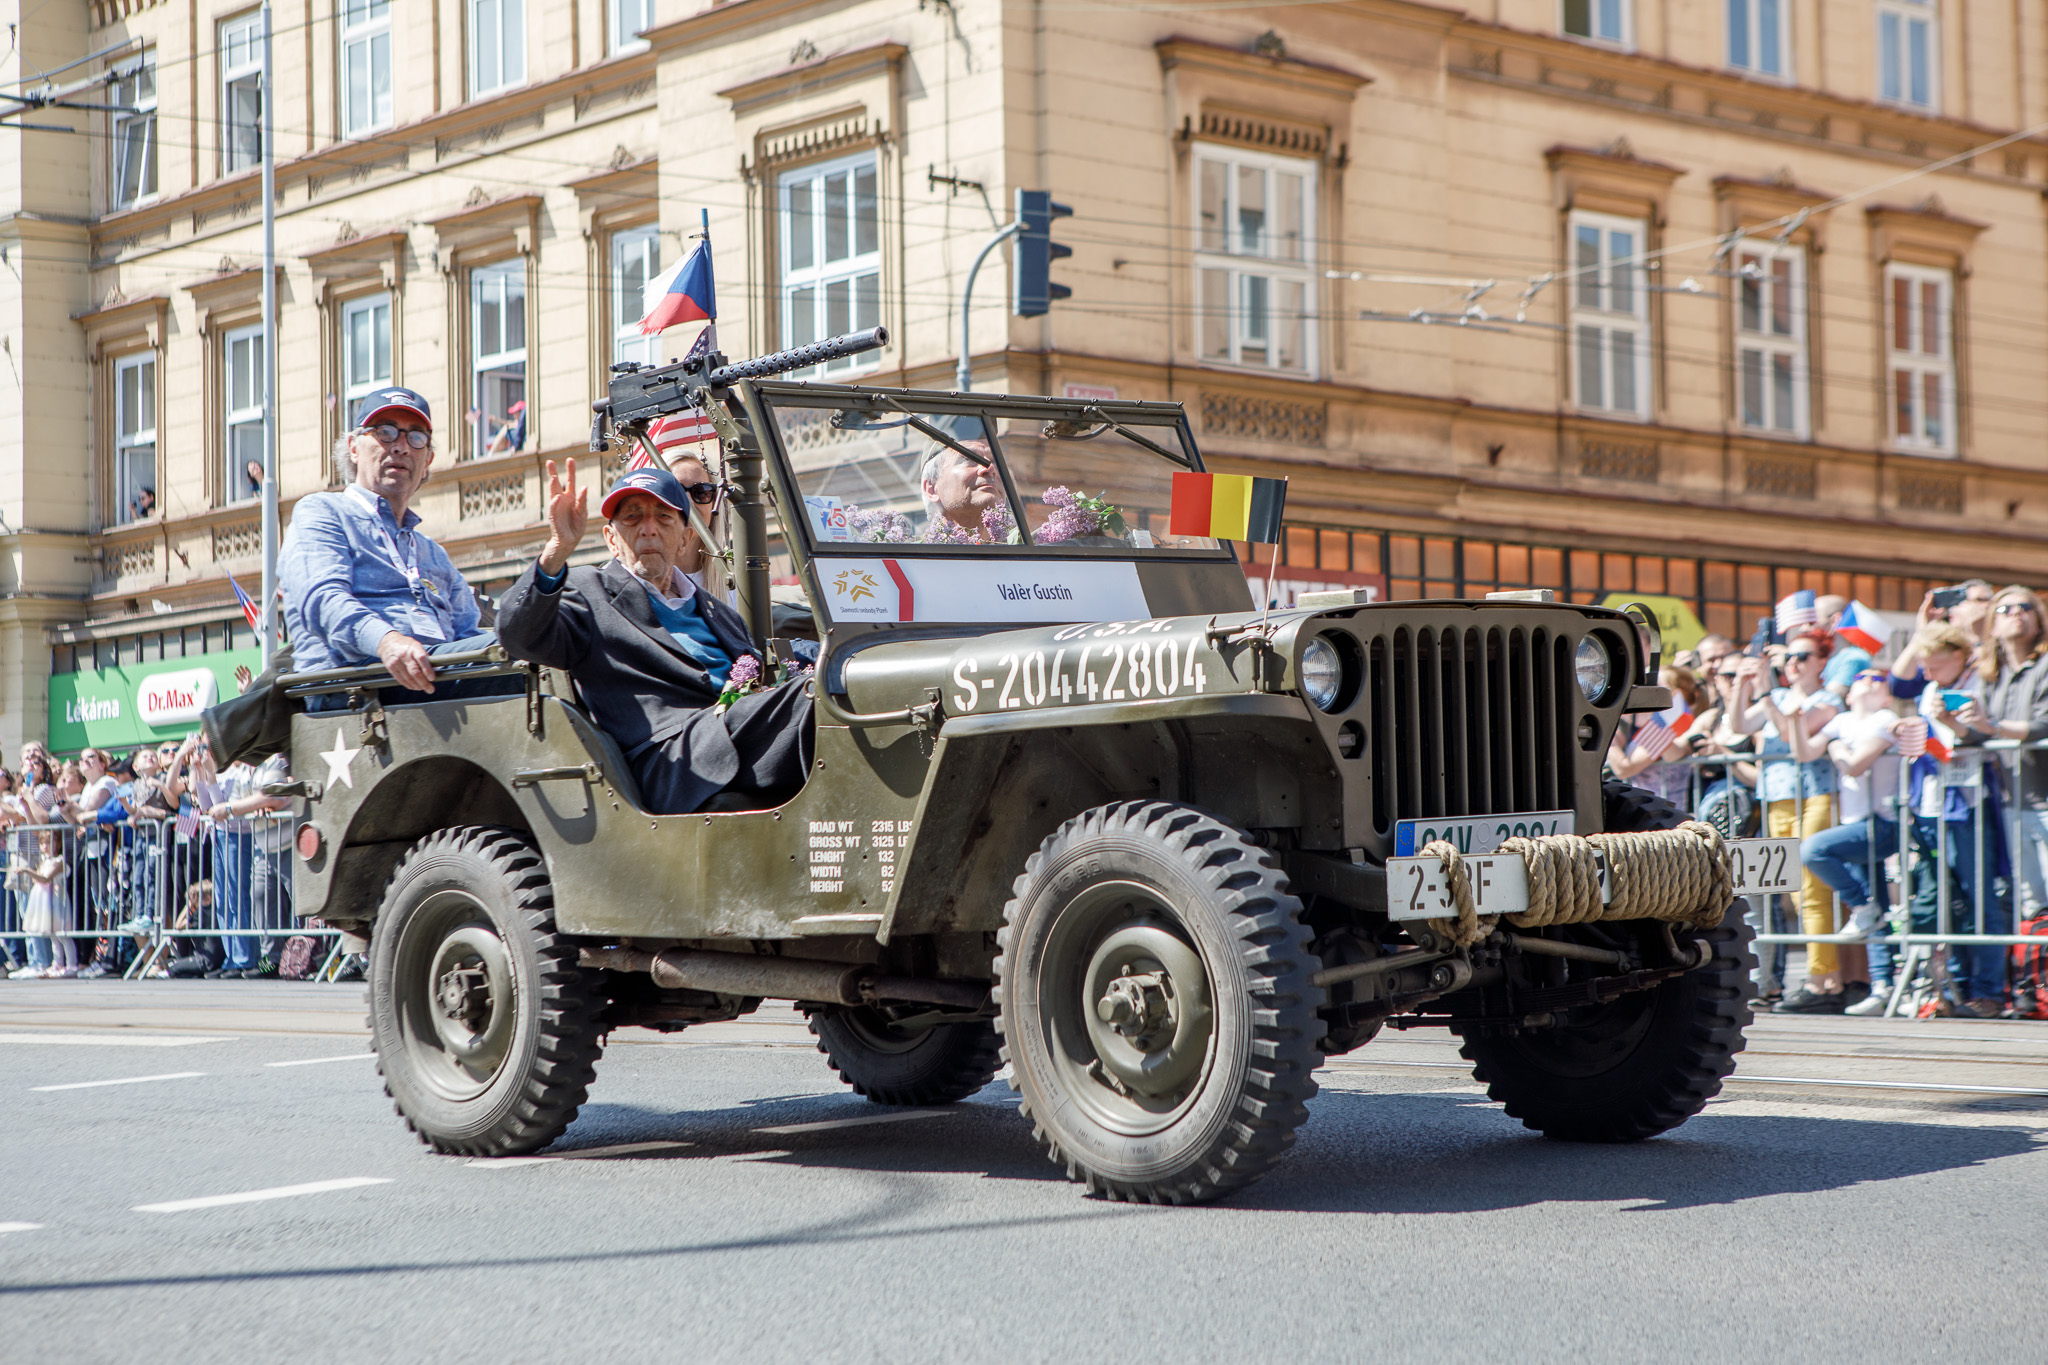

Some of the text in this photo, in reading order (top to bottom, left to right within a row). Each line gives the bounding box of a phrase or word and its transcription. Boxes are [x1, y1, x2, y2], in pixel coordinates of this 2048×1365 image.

[997, 583, 1073, 600] Valèr Gustin
[1053, 620, 1173, 641] U.S.A.
[953, 637, 1207, 712] S-20442804
[148, 689, 195, 713] Dr.Max
[66, 696, 120, 723] Lékárna
[809, 821, 835, 833] ROAD
[838, 821, 854, 833] WT
[872, 820, 894, 833] 2315
[809, 836, 842, 848] GROSS
[844, 836, 861, 848] WT
[872, 835, 894, 848] 3125
[810, 850, 894, 863] LENGHT 132
[810, 865, 894, 878] WIDTH 62
[810, 880, 894, 893] HEIGHT 52
